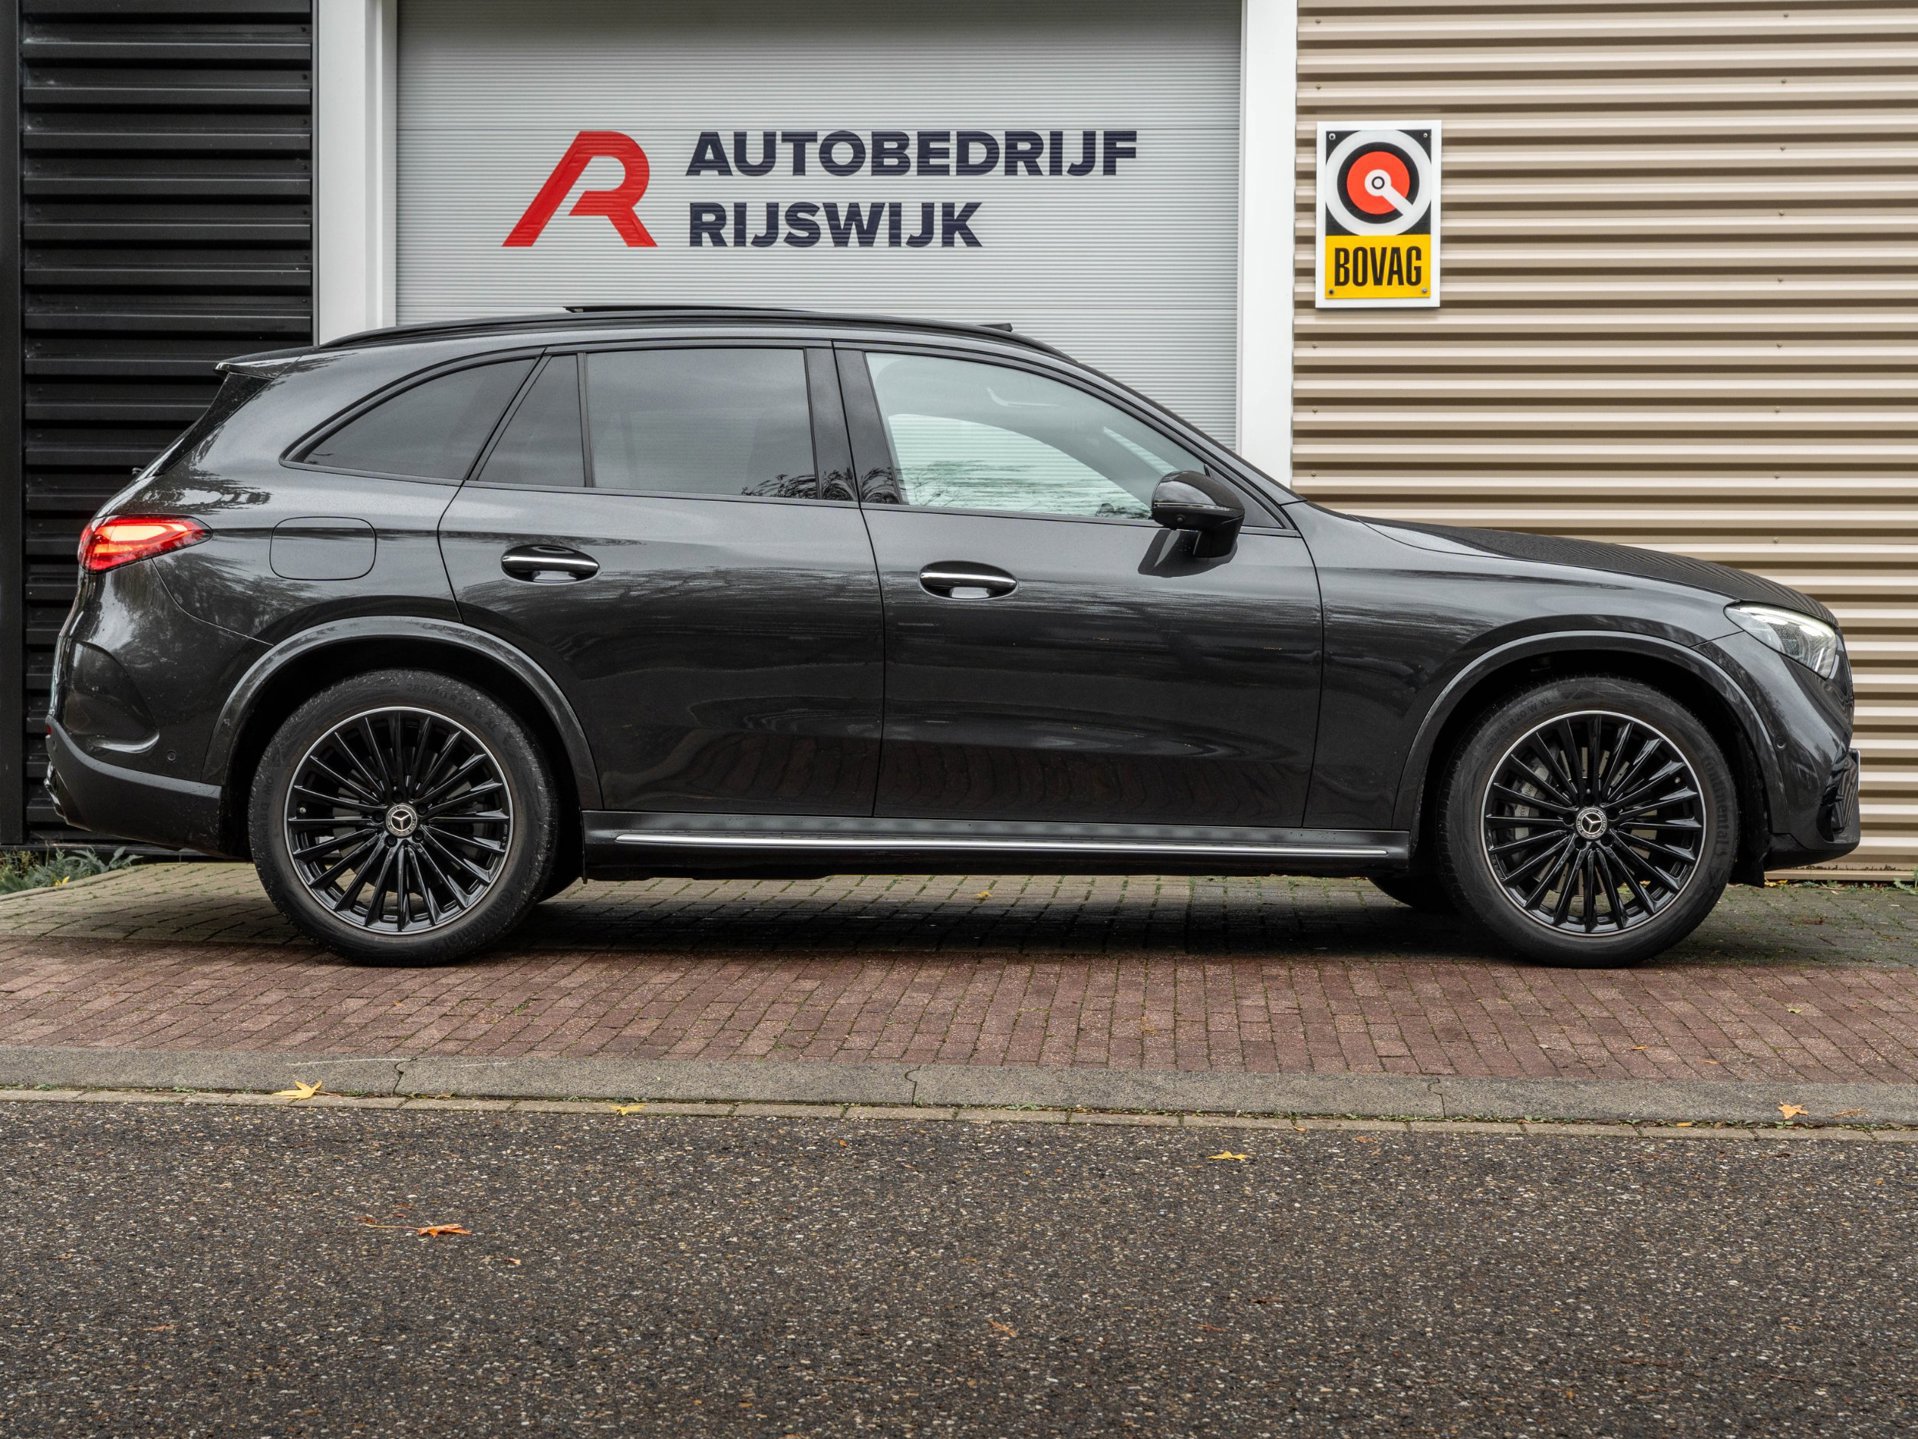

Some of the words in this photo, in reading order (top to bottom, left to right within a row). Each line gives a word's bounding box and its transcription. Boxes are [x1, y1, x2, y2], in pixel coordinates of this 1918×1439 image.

[685, 130, 1138, 176] AUTOBEDRIJF
[689, 202, 983, 248] RIJSWIJK
[1334, 246, 1422, 287] BOVAG
